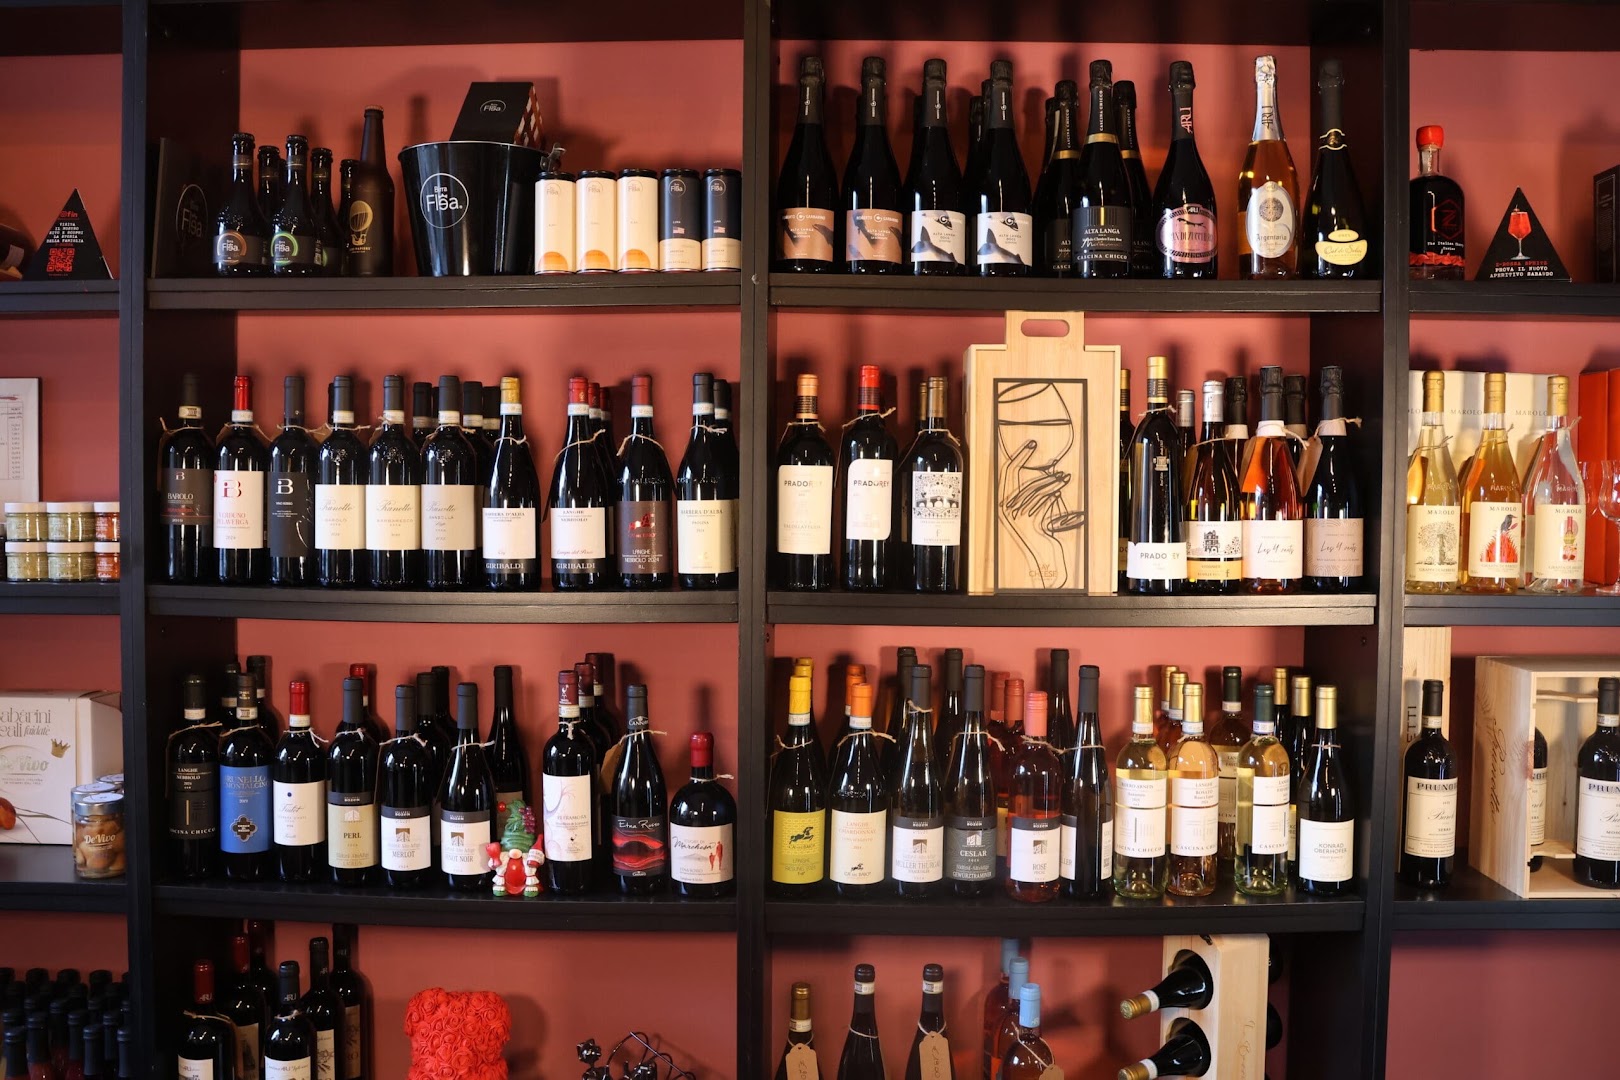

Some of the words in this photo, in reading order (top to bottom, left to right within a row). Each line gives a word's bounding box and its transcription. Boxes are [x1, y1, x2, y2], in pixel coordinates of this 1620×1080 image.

[1450, 408, 1483, 416] MAROLO
[1257, 542, 1271, 554] Les
[1320, 540, 1334, 552] Les
[1140, 552, 1180, 560] PRADOEY
[485, 562, 524, 570] GIRIBALDI
[556, 562, 596, 570] GIRIBALDI
[1028, 570, 1057, 578] CHEESE
[0, 707, 52, 724] abarini
[0, 722, 22, 738] eali
[1588, 783, 1620, 793] PRUN
[618, 819, 638, 829] Etna
[638, 819, 661, 829] Rosso
[84, 835, 96, 844] De
[95, 834, 116, 844] Vivo
[392, 850, 416, 858] MERLOT
[959, 849, 988, 858] CESLAR
[459, 855, 474, 863] NOIR
